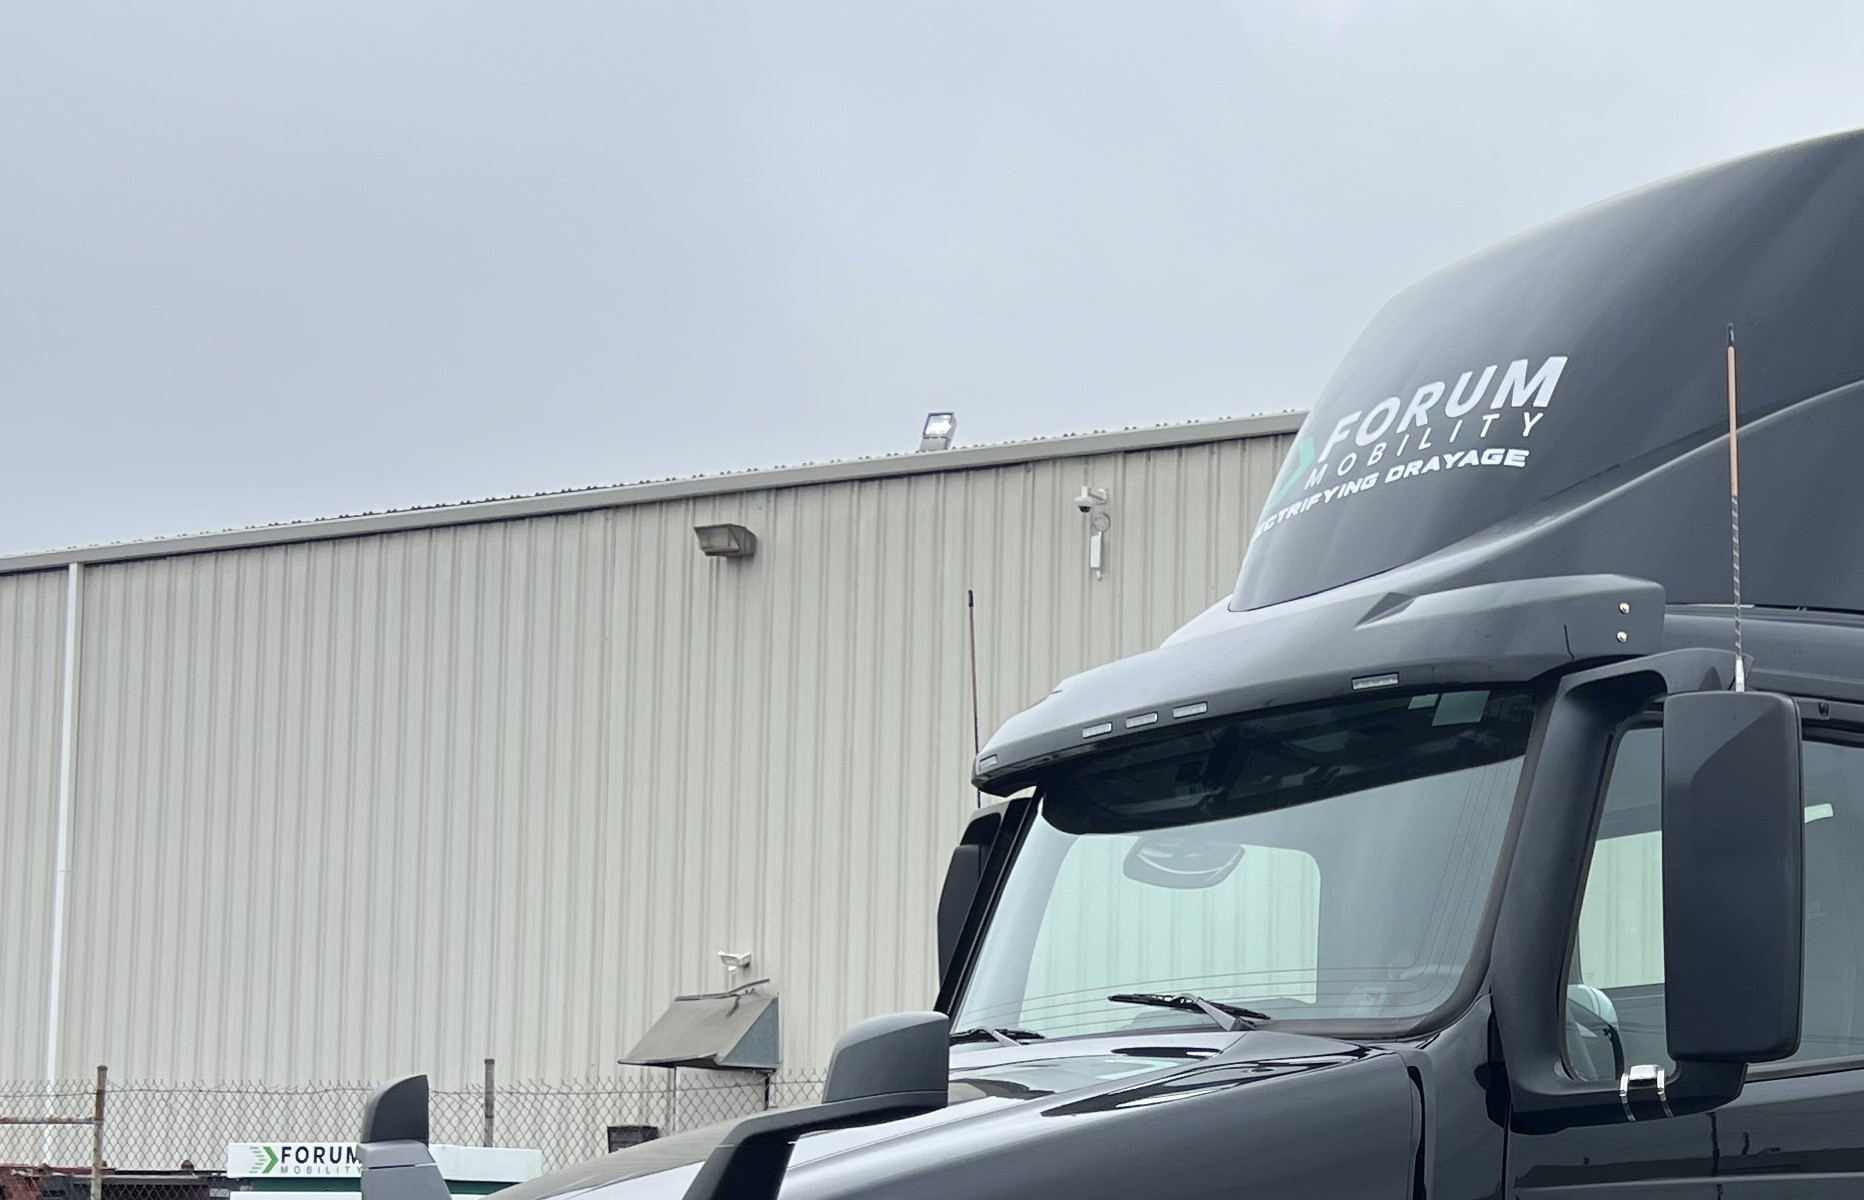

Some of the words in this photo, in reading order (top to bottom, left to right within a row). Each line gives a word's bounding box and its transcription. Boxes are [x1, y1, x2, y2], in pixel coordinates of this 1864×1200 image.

[1317, 355, 1568, 464] FORUM
[1304, 411, 1544, 491] MOBILITY
[1251, 472, 1380, 541] ECTRIFYING
[1385, 448, 1530, 484] DRAYAGE
[281, 1146, 362, 1164] FORUM
[281, 1166, 363, 1175] MOBILITY
